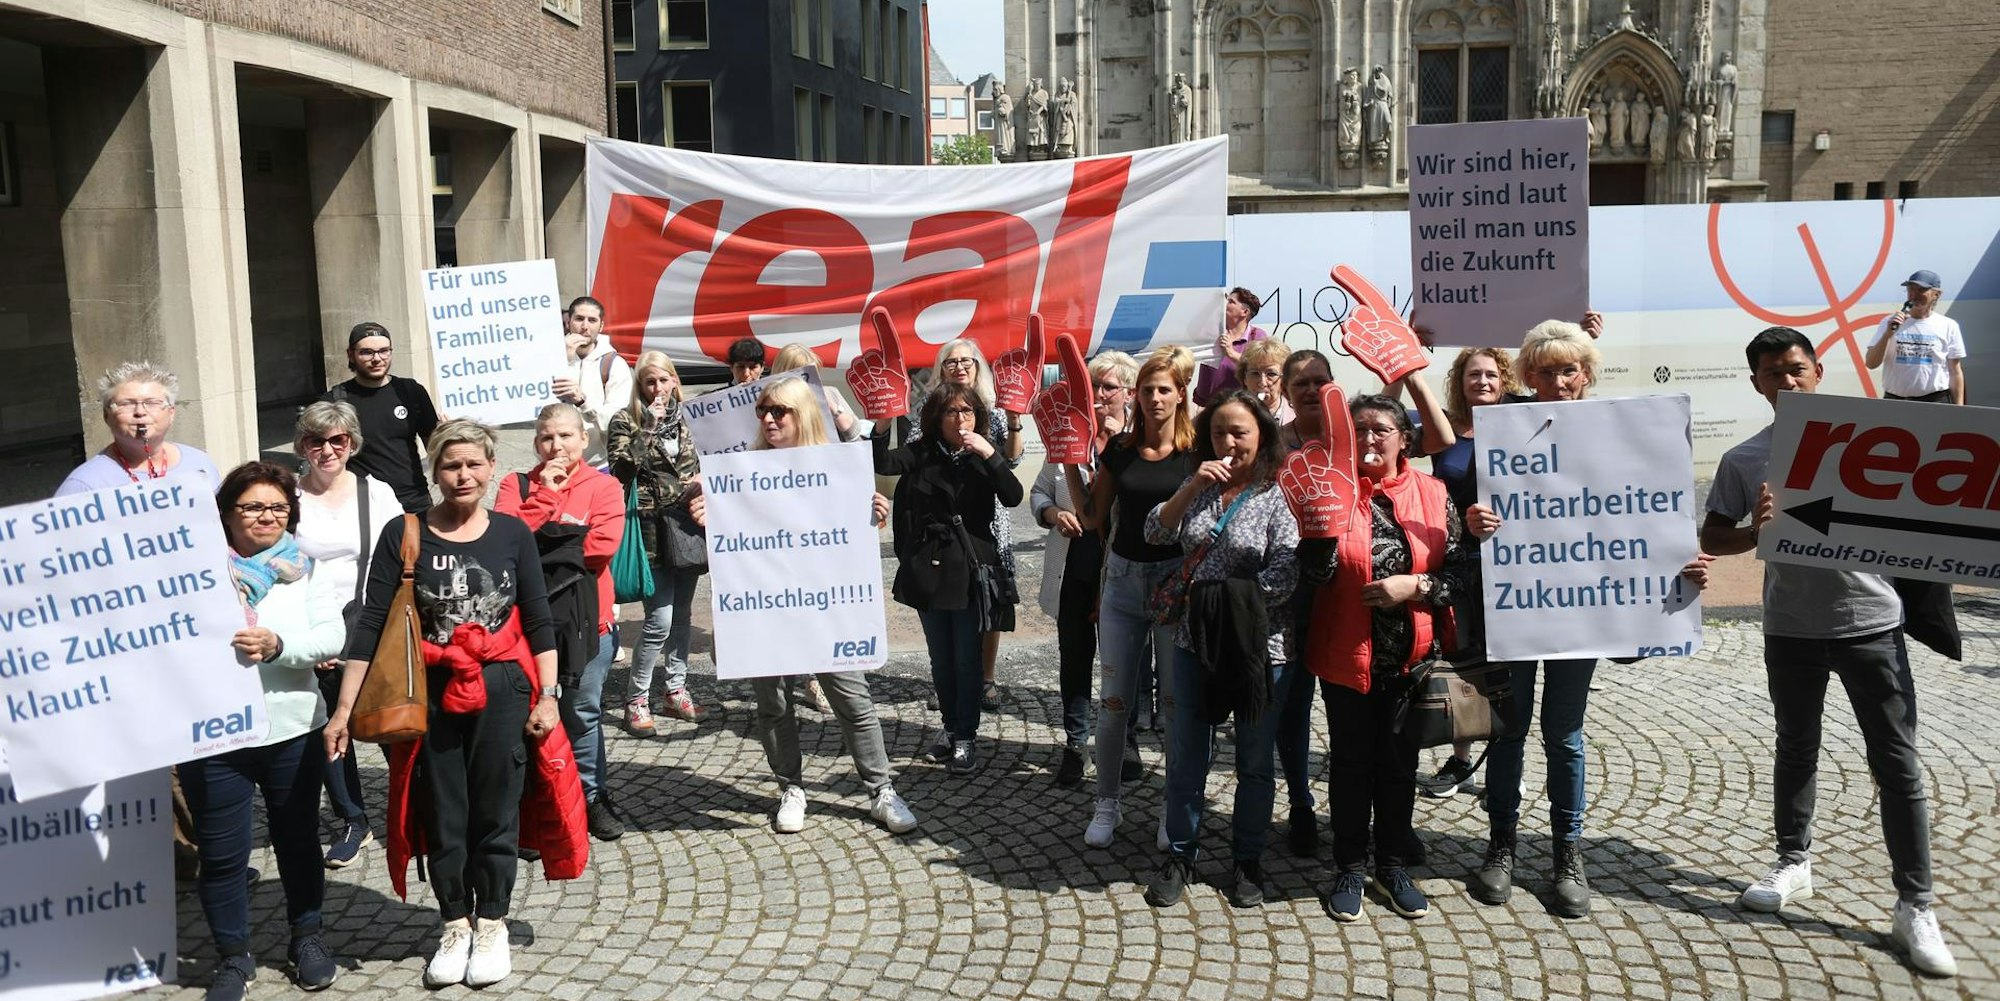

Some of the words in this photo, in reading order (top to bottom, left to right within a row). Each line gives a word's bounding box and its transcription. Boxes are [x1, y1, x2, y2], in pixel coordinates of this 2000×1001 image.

[1417, 154, 1456, 176] Wir
[1463, 149, 1512, 174] sind
[1521, 148, 1576, 172] hier,
[1417, 187, 1454, 208] wir
[1462, 183, 1510, 207] sind
[1520, 182, 1567, 204] laut
[1419, 218, 1466, 240] weil
[1475, 221, 1525, 239] man
[1535, 219, 1577, 236] uns
[1420, 251, 1455, 272] die
[1462, 248, 1556, 272] Zukunft
[428, 271, 463, 291] Für
[470, 269, 508, 286] uns
[1421, 283, 1488, 304] klaut!
[432, 297, 473, 320] und
[481, 294, 551, 315] unsere
[436, 324, 534, 349] Familien,
[440, 354, 513, 379] schaut
[445, 384, 500, 408] nicht
[686, 403, 723, 420] Wer
[1488, 444, 1558, 477] Real
[1784, 420, 2000, 511] rea
[709, 474, 743, 494] Wir
[750, 470, 828, 492] fordern
[32, 493, 106, 534] sind
[115, 484, 195, 518] hier,
[1490, 485, 1684, 521] Mitarbeiter
[40, 537, 114, 579] sind
[123, 524, 194, 561] laut
[713, 529, 793, 553] Zukunft
[800, 527, 849, 547] statt
[1493, 532, 1648, 566] brauchen
[70, 583, 147, 618] man
[158, 568, 217, 598] uns
[719, 584, 874, 612] Kahlschlag!!!!!
[1495, 576, 1683, 610] Zukunft!!!!
[60, 611, 199, 665] Zukunft
[833, 636, 877, 658] real
[5, 675, 112, 723] klaut!
[192, 704, 253, 743] real
[66, 881, 147, 916] nicht
[104, 952, 167, 986] real
